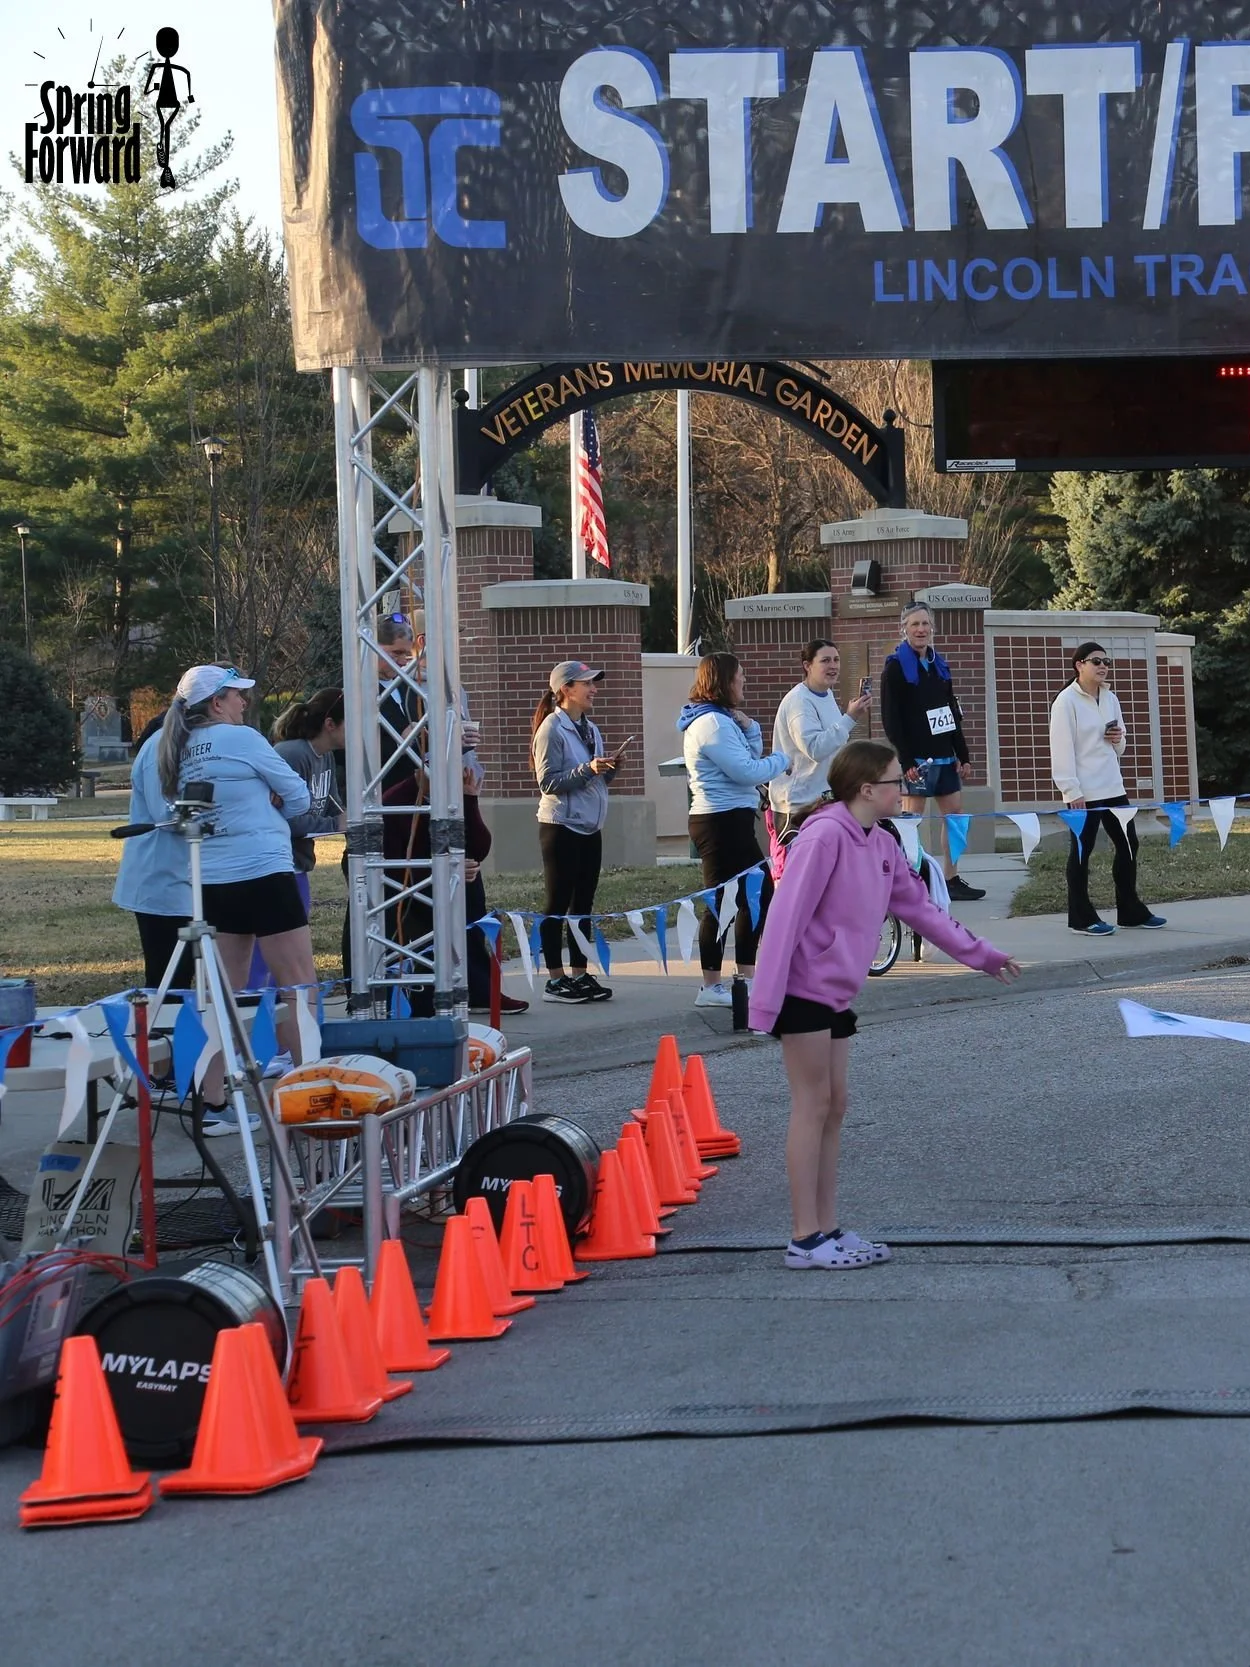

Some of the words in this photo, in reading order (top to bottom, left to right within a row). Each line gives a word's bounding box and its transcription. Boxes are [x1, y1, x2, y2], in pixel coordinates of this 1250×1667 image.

[873, 255, 1116, 302] LINCOLN
[480, 360, 614, 446] VETERANS
[624, 361, 768, 398] MEMORIAL
[775, 377, 880, 466] GARDEN
[743, 604, 754, 612] US
[756, 604, 782, 612] Marine
[783, 603, 805, 613] Corps
[928, 594, 940, 603] US
[966, 594, 990, 602] Guard
[520, 1193, 539, 1271] LTC
[101, 1352, 212, 1383] MYLAPS
[136, 1381, 178, 1393] EASYMAT
